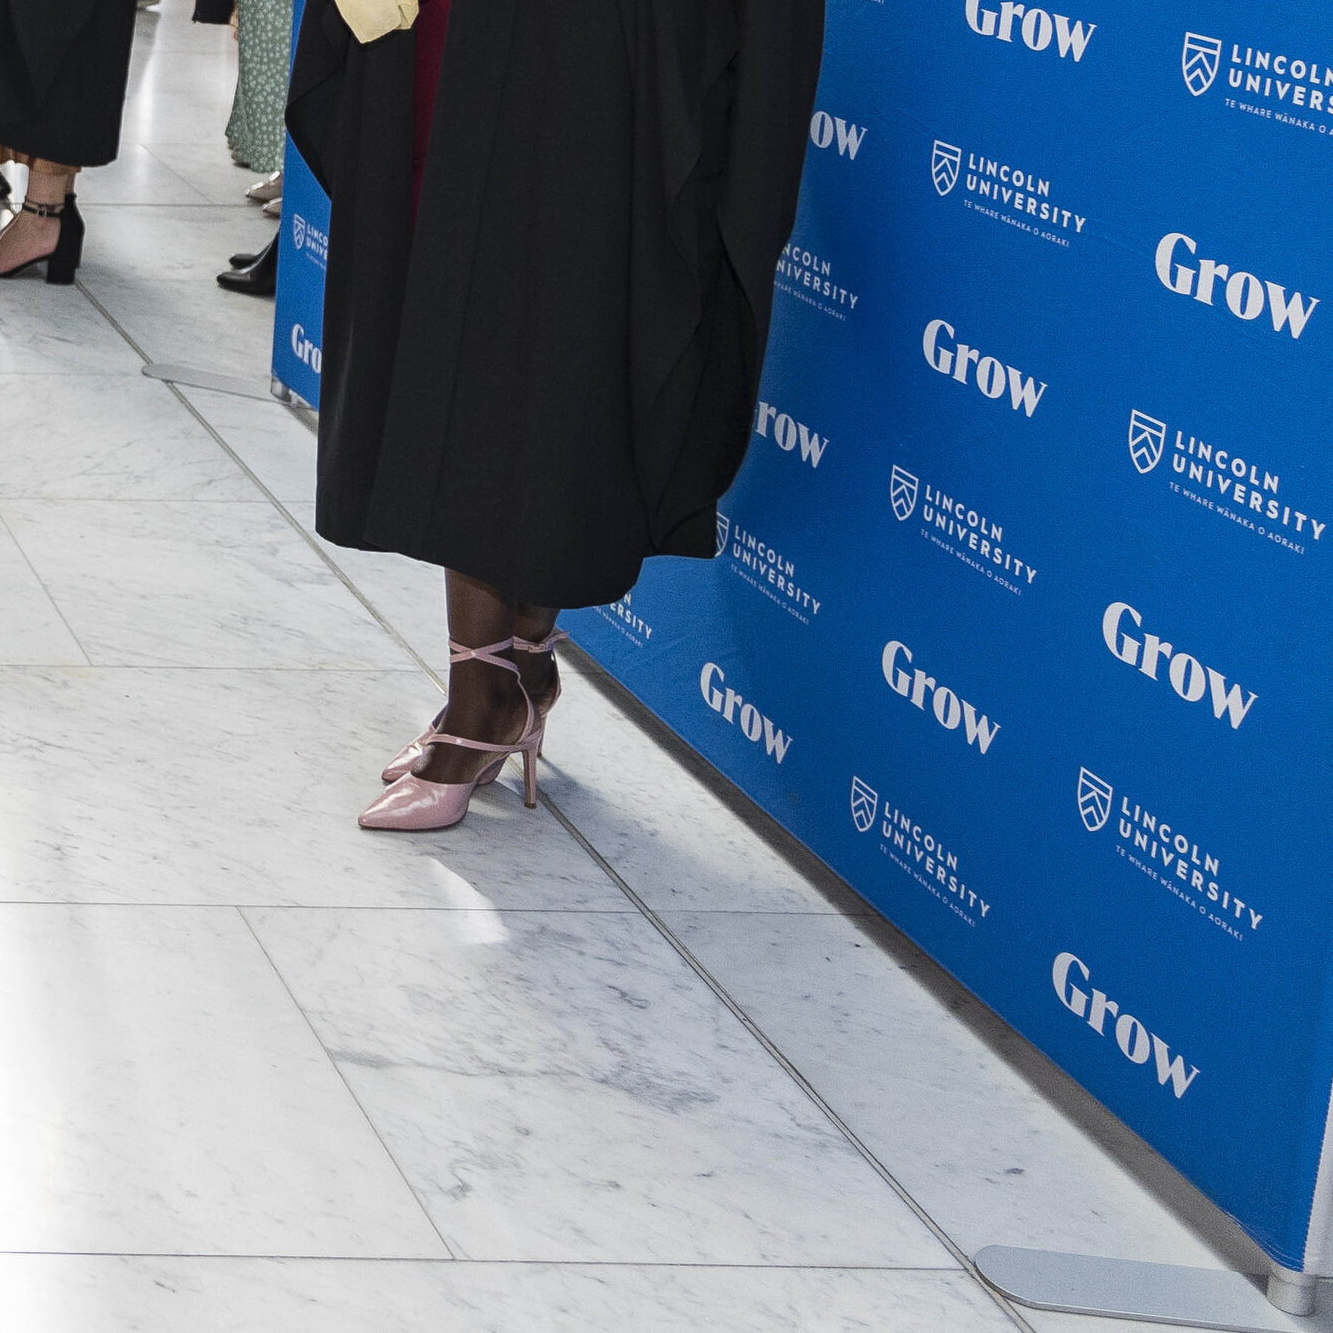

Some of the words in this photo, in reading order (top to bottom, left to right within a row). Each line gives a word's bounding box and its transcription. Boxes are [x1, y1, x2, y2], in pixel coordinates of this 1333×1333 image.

[1224, 97, 1236, 108] TE
[1238, 101, 1272, 118] WHARE
[1229, 68, 1333, 114] UNIVER
[810, 111, 867, 160] ow
[967, 174, 1085, 232] UNIVERSITY
[969, 154, 1049, 196] LINCOLN
[306, 222, 328, 244] LINCO
[306, 236, 328, 260] UNIVE
[782, 244, 830, 275] NCOLN
[777, 260, 857, 308] NIVERSITY
[1155, 233, 1320, 339] Grow
[291, 323, 322, 373] Gro
[923, 320, 1047, 417] Grow
[756, 402, 829, 468] row
[1176, 431, 1278, 493] LINCOLN
[926, 485, 1002, 542] LINCOLN
[1168, 481, 1179, 493] TE
[1182, 488, 1214, 510] WHARE
[1267, 530, 1305, 555] AORAKI
[1173, 454, 1325, 539] UNIVERSITY
[735, 526, 794, 577] LINCOLN
[924, 505, 1036, 583] UNIVERSITY
[733, 544, 820, 614] UNIVERSITY
[610, 603, 652, 638] ERSITY
[882, 641, 1000, 754] Grow
[1103, 602, 1258, 729] Grow
[700, 663, 792, 763] Grow
[883, 821, 990, 917] UNIVERSITY
[885, 802, 957, 870] LINCOLN
[1122, 797, 1218, 876] LINCOLN
[1115, 844, 1125, 857] TE
[1128, 853, 1158, 880] WHARE
[1208, 909, 1243, 940] AORAKI
[1120, 819, 1262, 929] UNIVERSITY
[1053, 952, 1200, 1098] Grow
